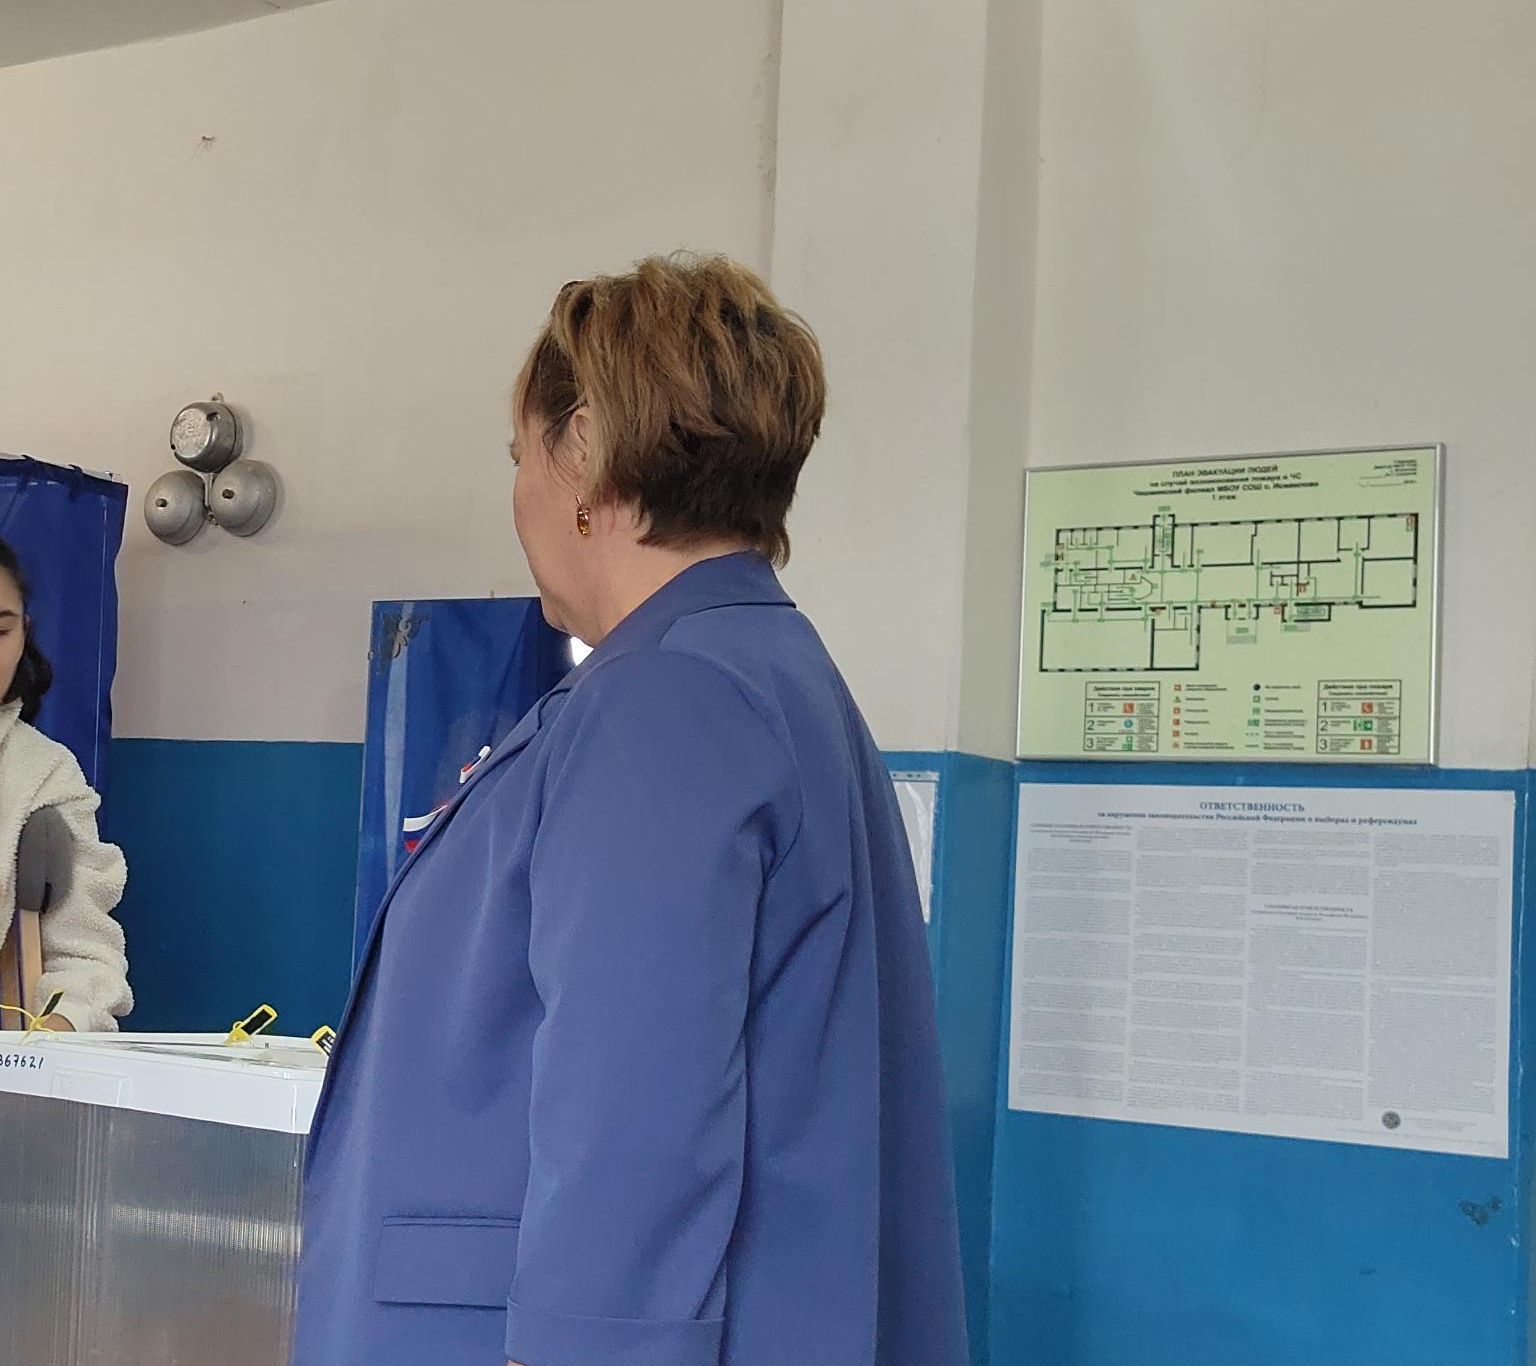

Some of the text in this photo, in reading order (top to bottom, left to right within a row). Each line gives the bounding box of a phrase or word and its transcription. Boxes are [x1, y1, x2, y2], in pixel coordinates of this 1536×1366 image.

[1172, 464, 1278, 478] ПЛАН ЭВАКУАЦИИ ЛЮДЕЙ
[1242, 483, 1263, 491] СОШ
[1088, 702, 1094, 713] 1
[1321, 702, 1328, 713] 1
[1087, 719, 1095, 731] 2
[1319, 719, 1328, 732] 2
[1086, 737, 1094, 749] 3
[1319, 738, 1328, 750] 3
[1199, 801, 1305, 813] ОТВЕТСТВЕННОСТЬ
